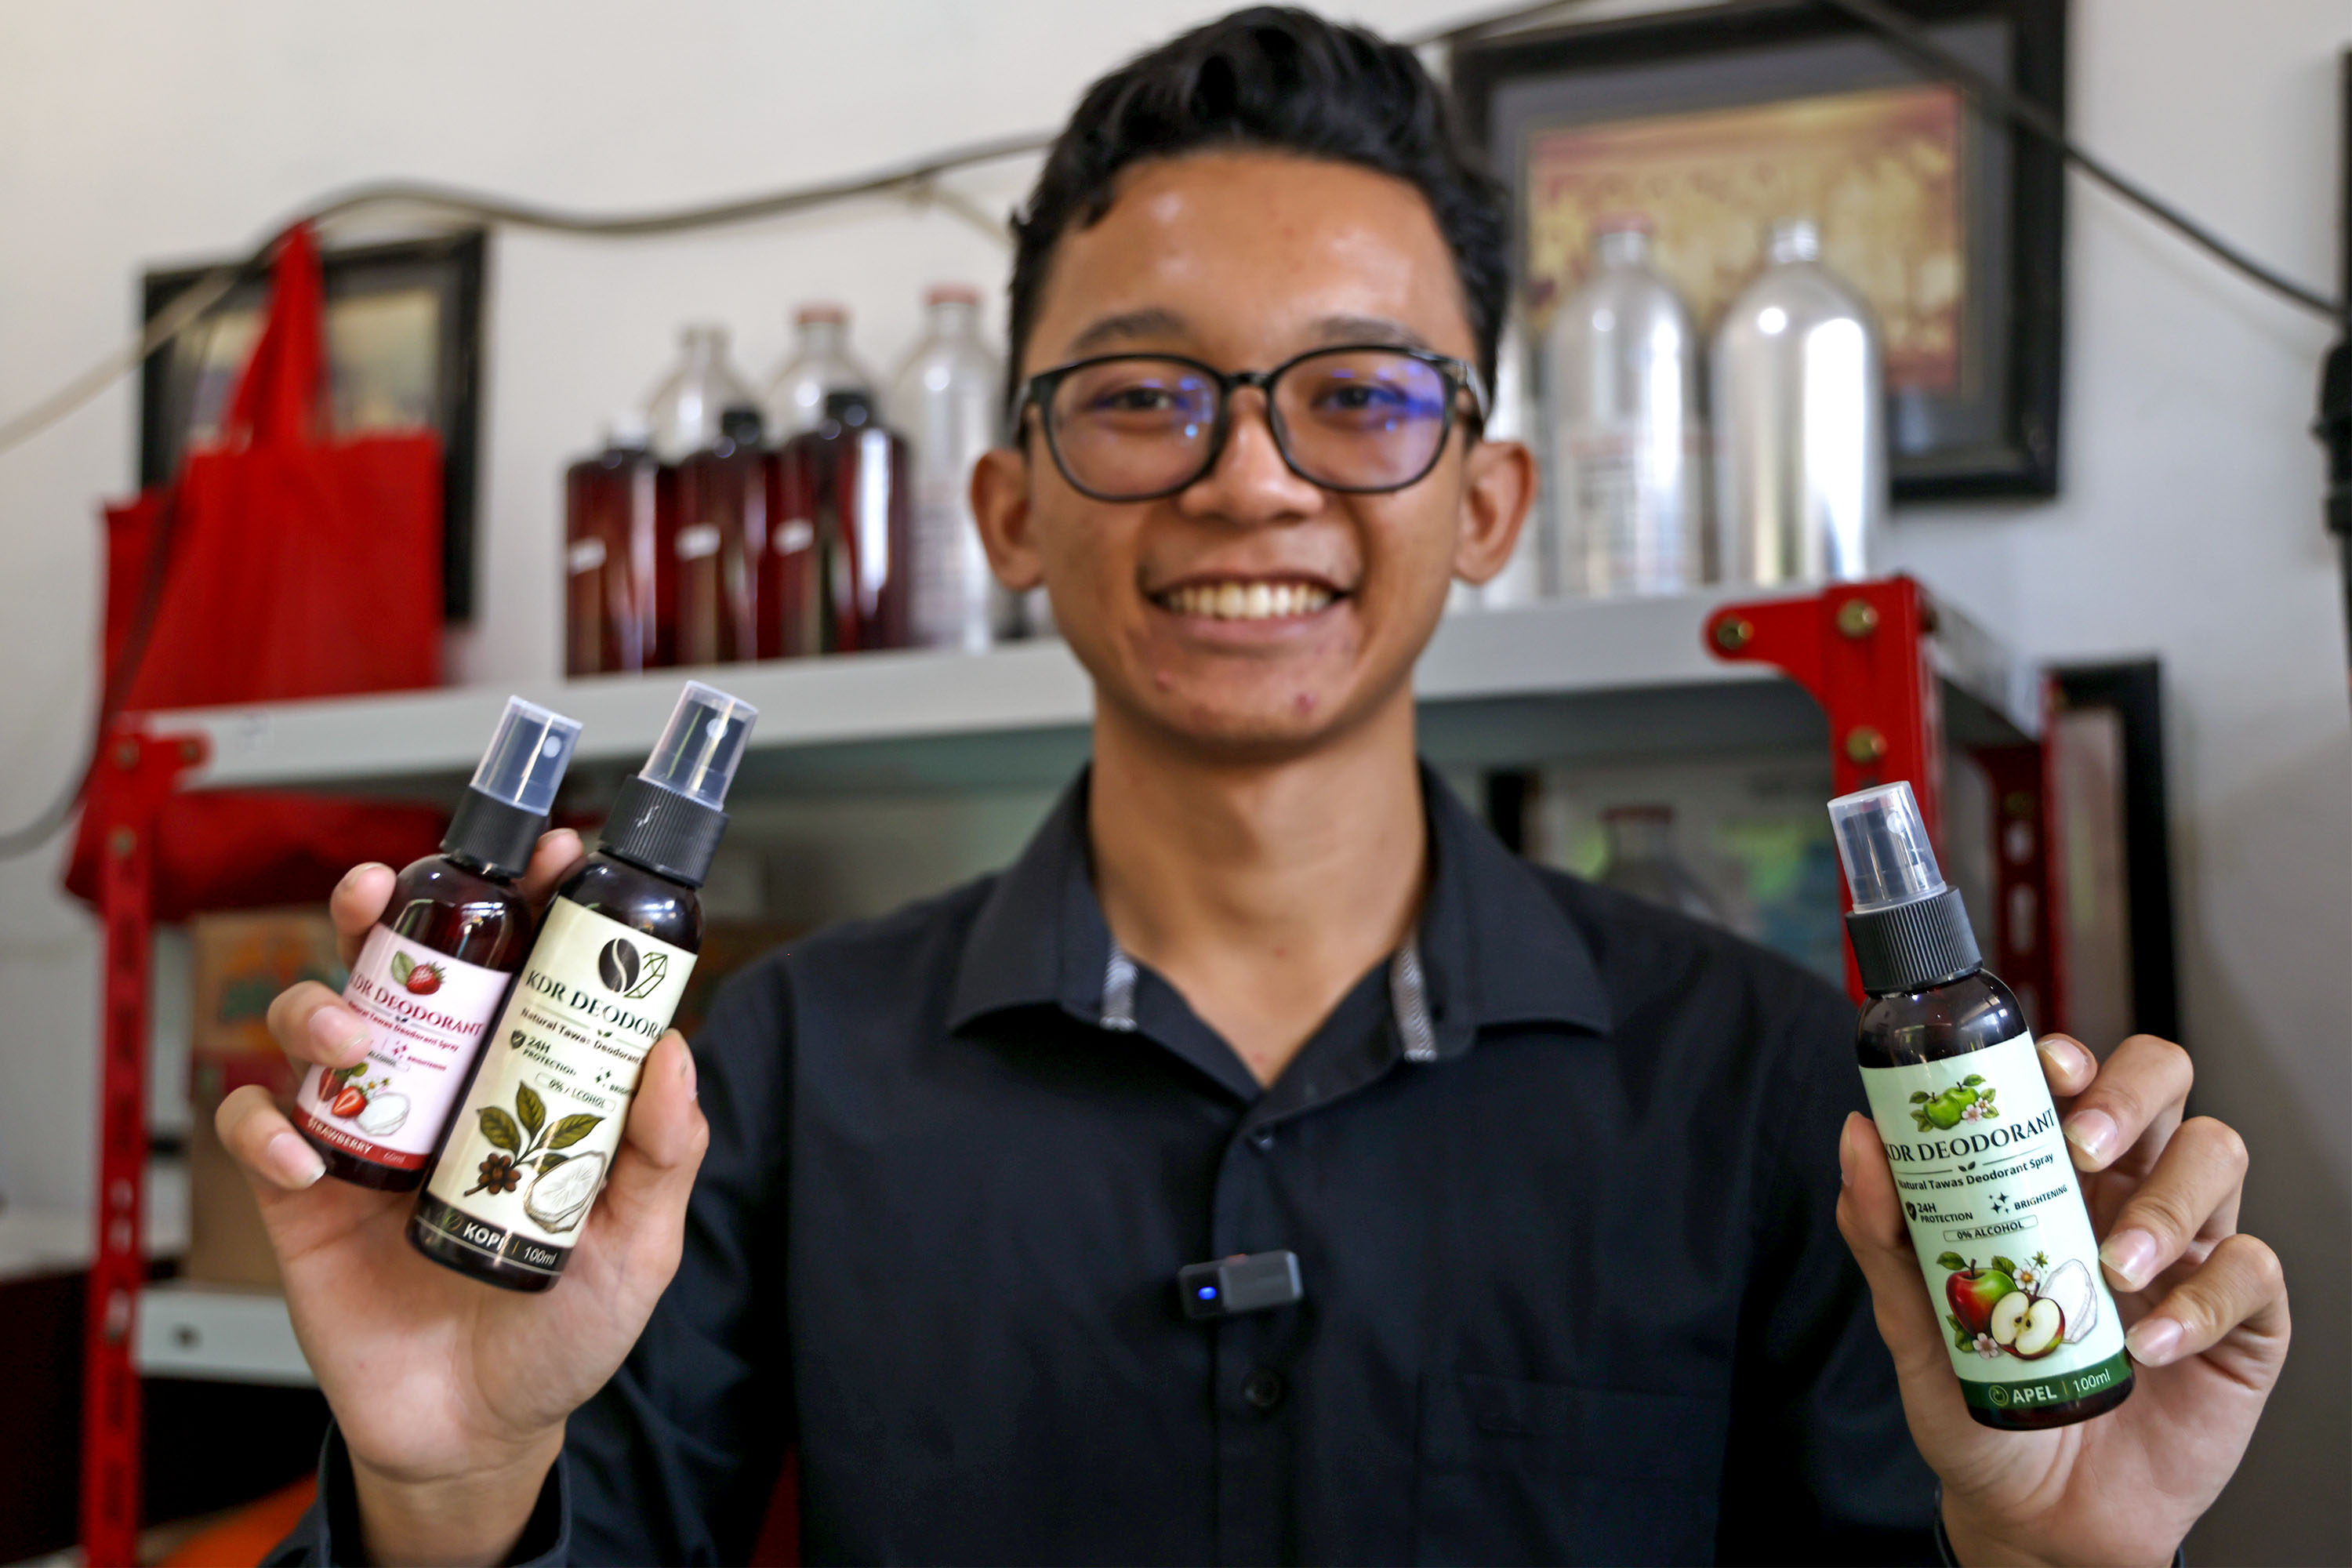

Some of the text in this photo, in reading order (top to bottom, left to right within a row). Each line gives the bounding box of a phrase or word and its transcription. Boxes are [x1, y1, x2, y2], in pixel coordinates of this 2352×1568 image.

[526, 971, 566, 1001] KDR
[374, 985, 484, 1036] DEODORANT
[521, 1007, 557, 1032] Natural
[394, 1024, 437, 1046] Deodorant
[527, 1036, 551, 1054] 24H
[307, 1117, 374, 1155] STRAWBERRY
[1918, 1108, 2056, 1160] DEODORANT
[1897, 1152, 2054, 1190] Natural Tawas Deodorant Spray
[1918, 1202, 1936, 1213] 24H
[2014, 1185, 2067, 1210] BRIGHTENING
[1921, 1212, 1973, 1223] PROTECTION
[1957, 1221, 2025, 1240] 0% ALCOHOL
[463, 1222, 557, 1267] KOPI 100ml
[2013, 1368, 2111, 1404] APEL 100ml
